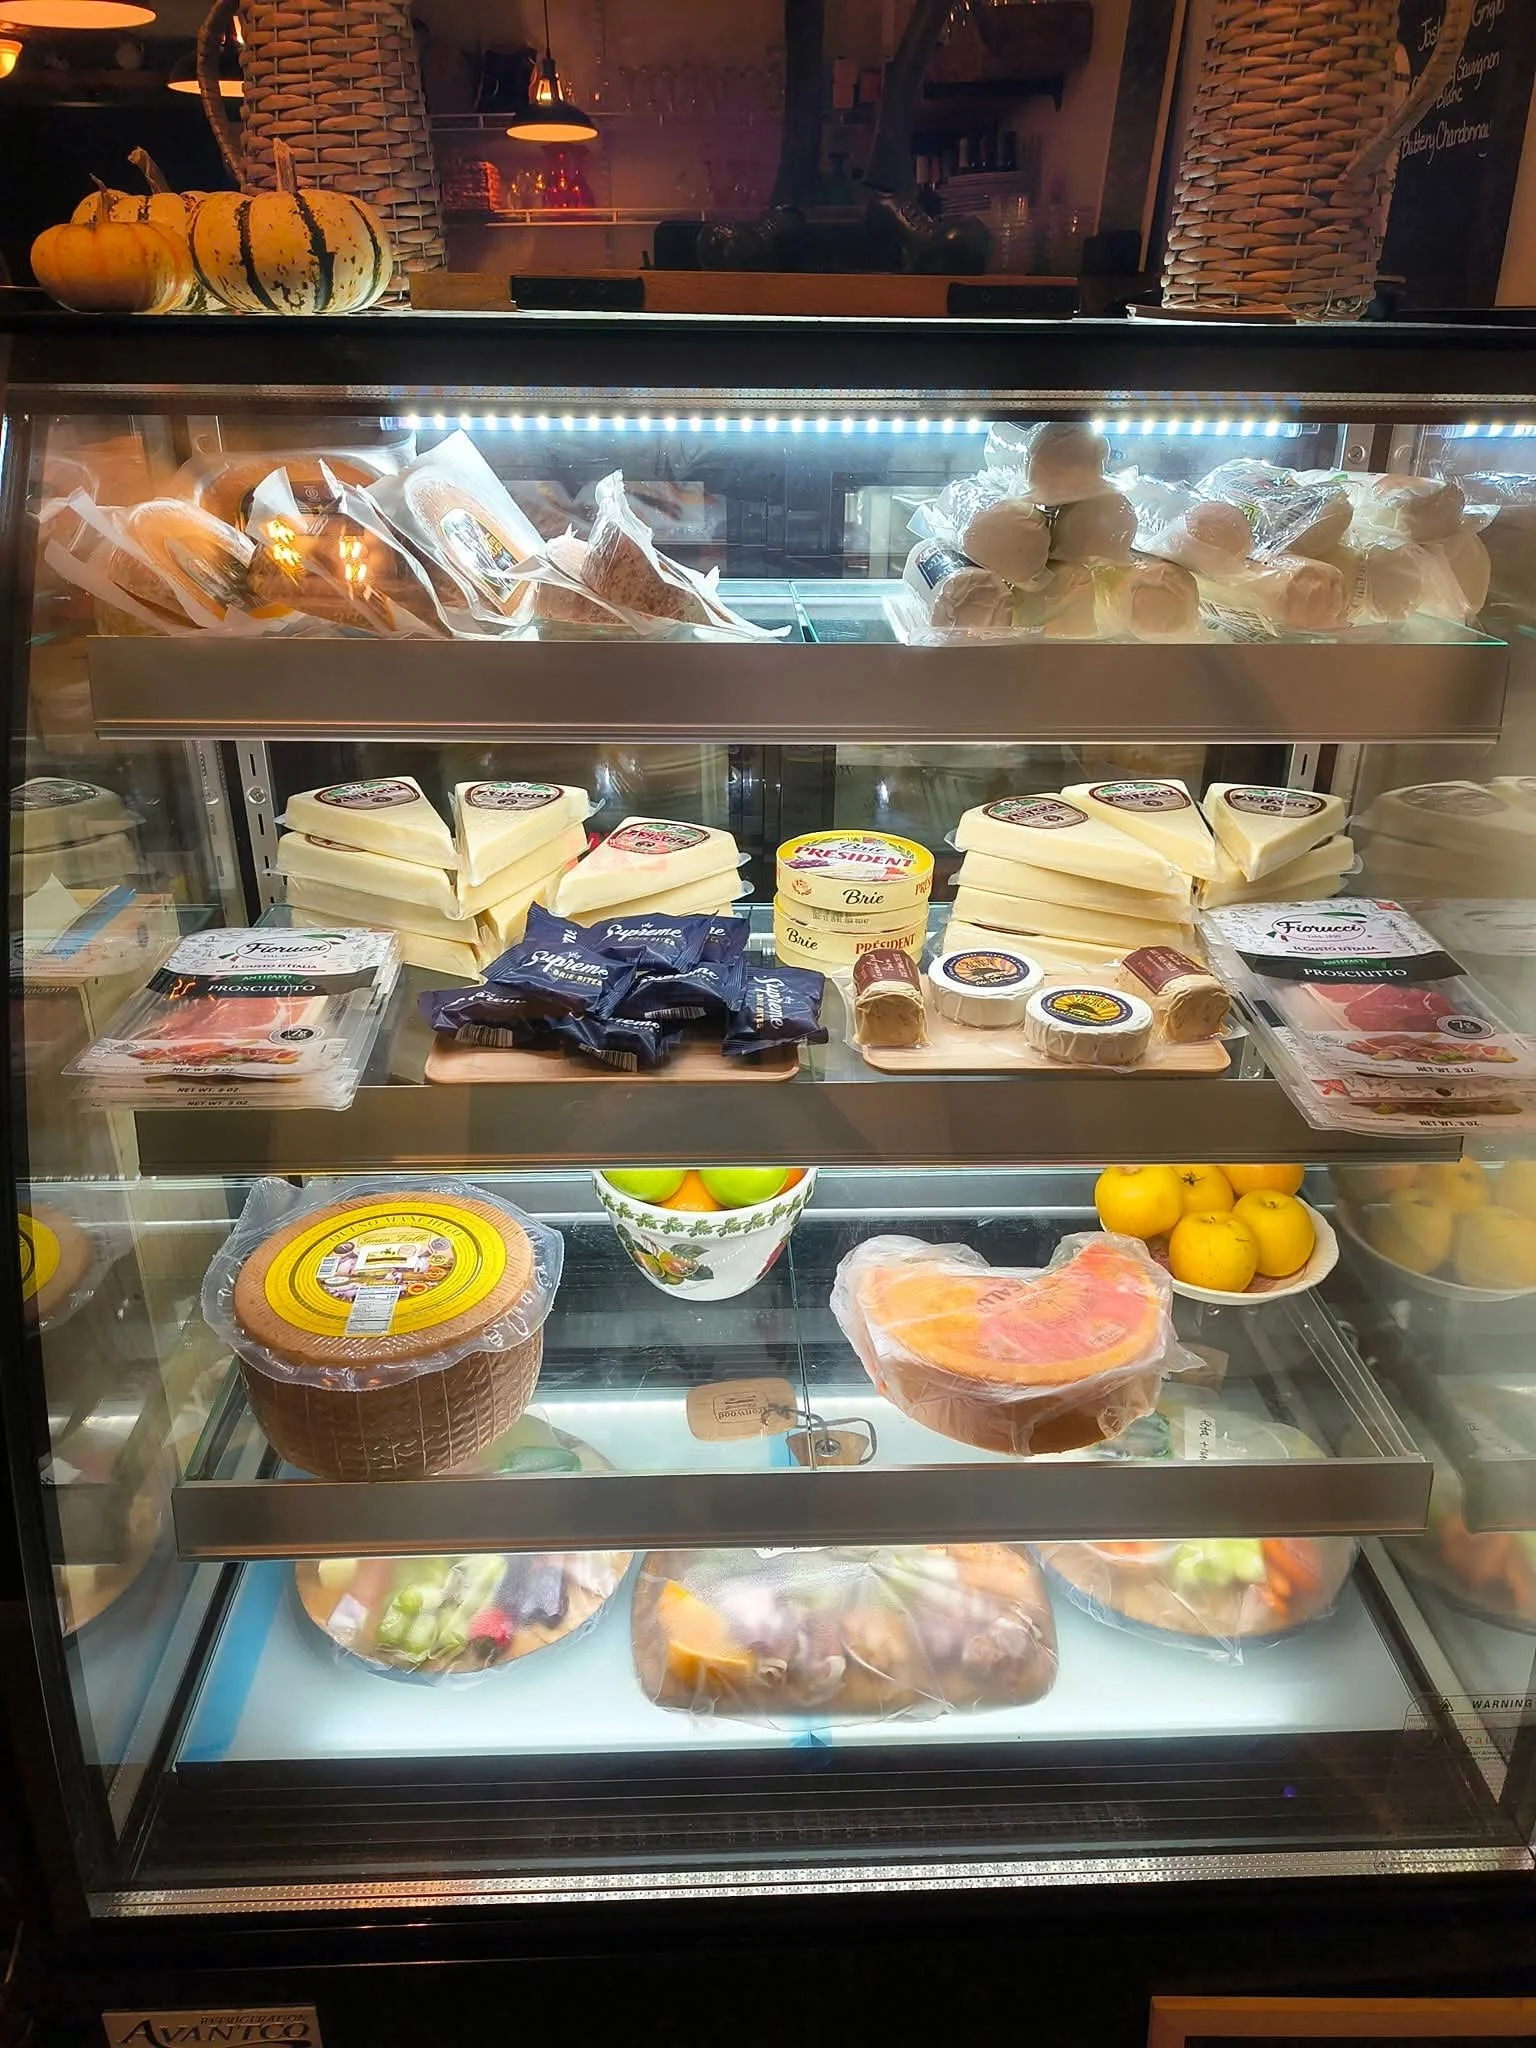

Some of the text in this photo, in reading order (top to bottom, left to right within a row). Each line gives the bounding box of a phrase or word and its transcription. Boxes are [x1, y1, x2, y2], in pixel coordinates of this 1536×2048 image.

[842, 889, 886, 905] Brie
[600, 924, 683, 942] Supreme
[1276, 921, 1361, 933] Fiorucci
[786, 927, 818, 951] Brie
[243, 943, 328, 955] Fiorucci
[520, 950, 609, 980] Supreme
[1303, 967, 1408, 978] PROSCIUTTO
[207, 984, 316, 993] PROSCIUTTO
[753, 976, 785, 1029] Supreme
[1471, 1699, 1533, 1710] WARNING
[118, 2018, 311, 2045] AVANTCO
